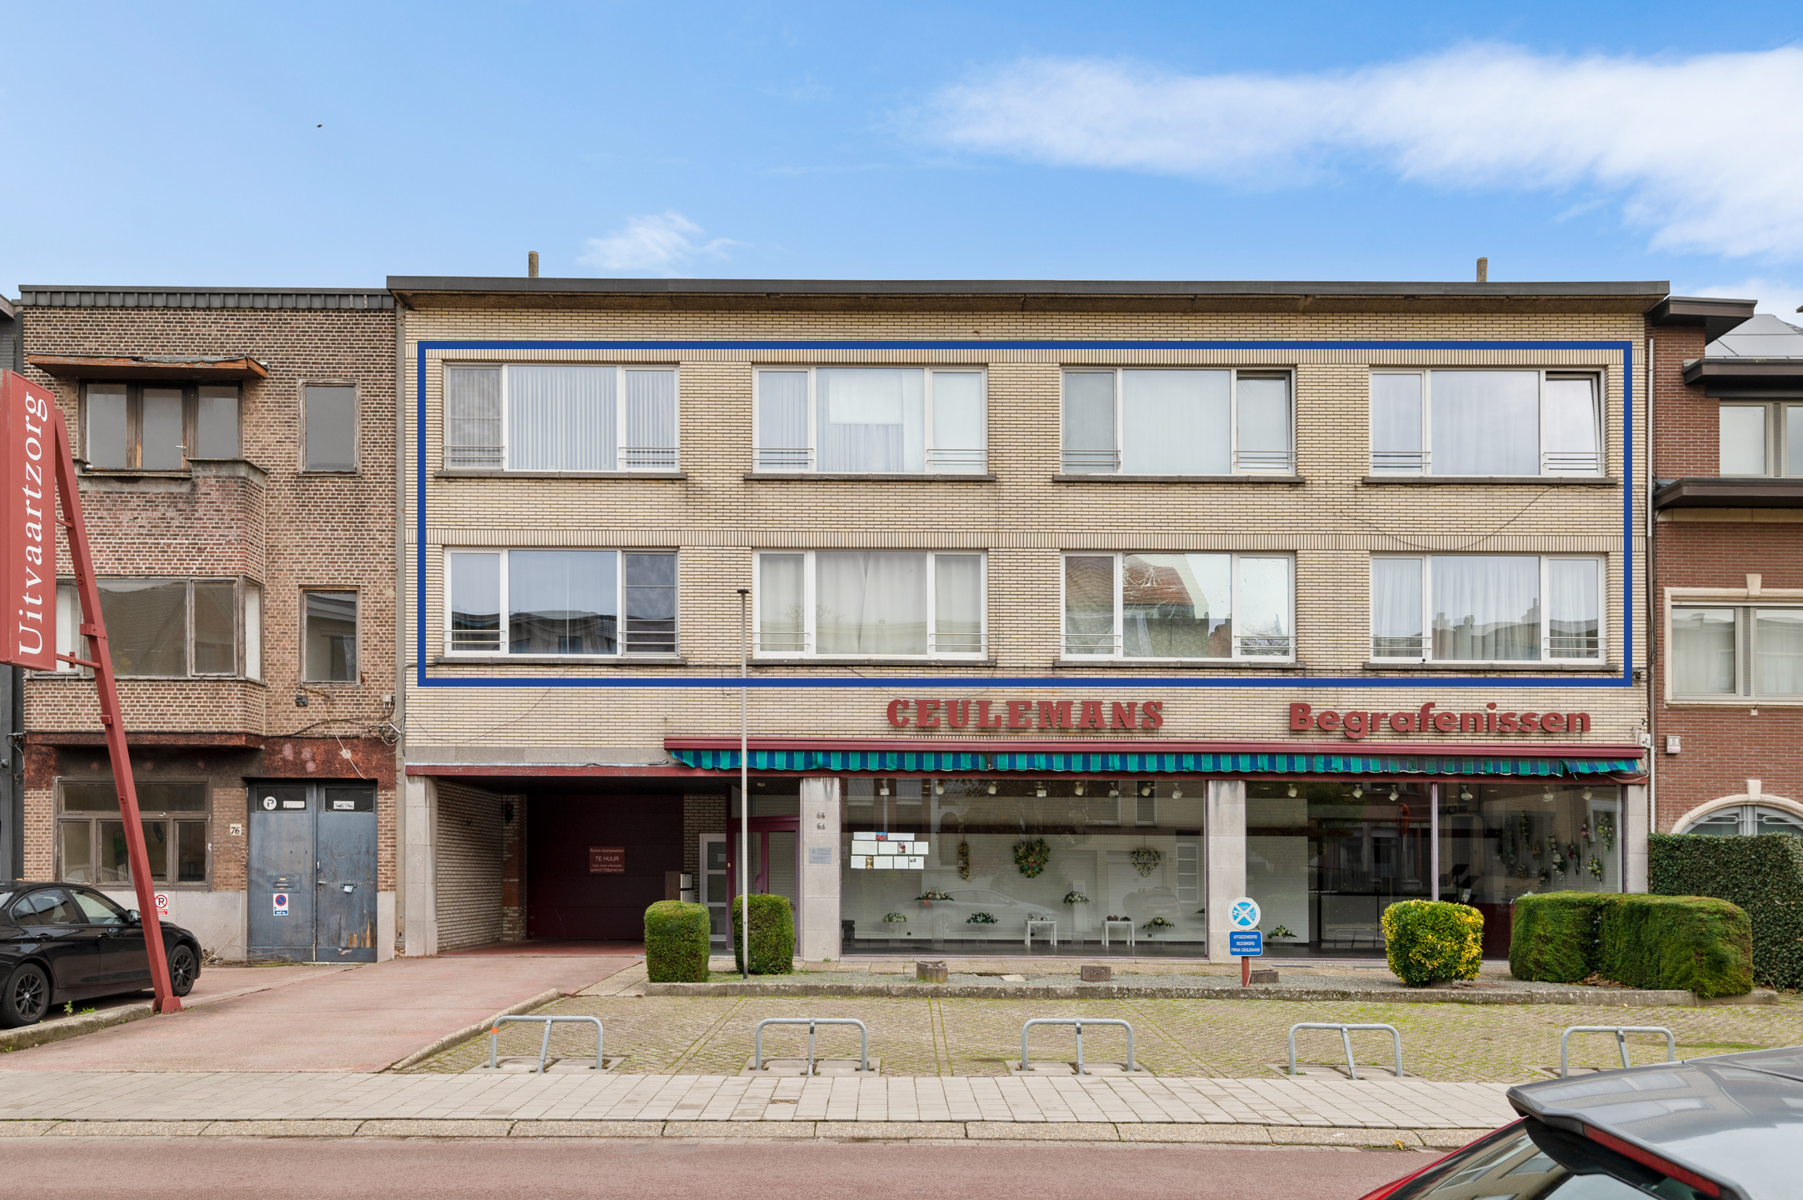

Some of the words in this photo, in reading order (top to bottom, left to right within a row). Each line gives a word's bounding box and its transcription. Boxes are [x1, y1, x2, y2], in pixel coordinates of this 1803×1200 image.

[18, 390, 49, 656] Uitvaartzorg
[886, 699, 1164, 729] CEULEMANS
[1289, 701, 1591, 739] Begrafenissen
[231, 826, 240, 835] 76
